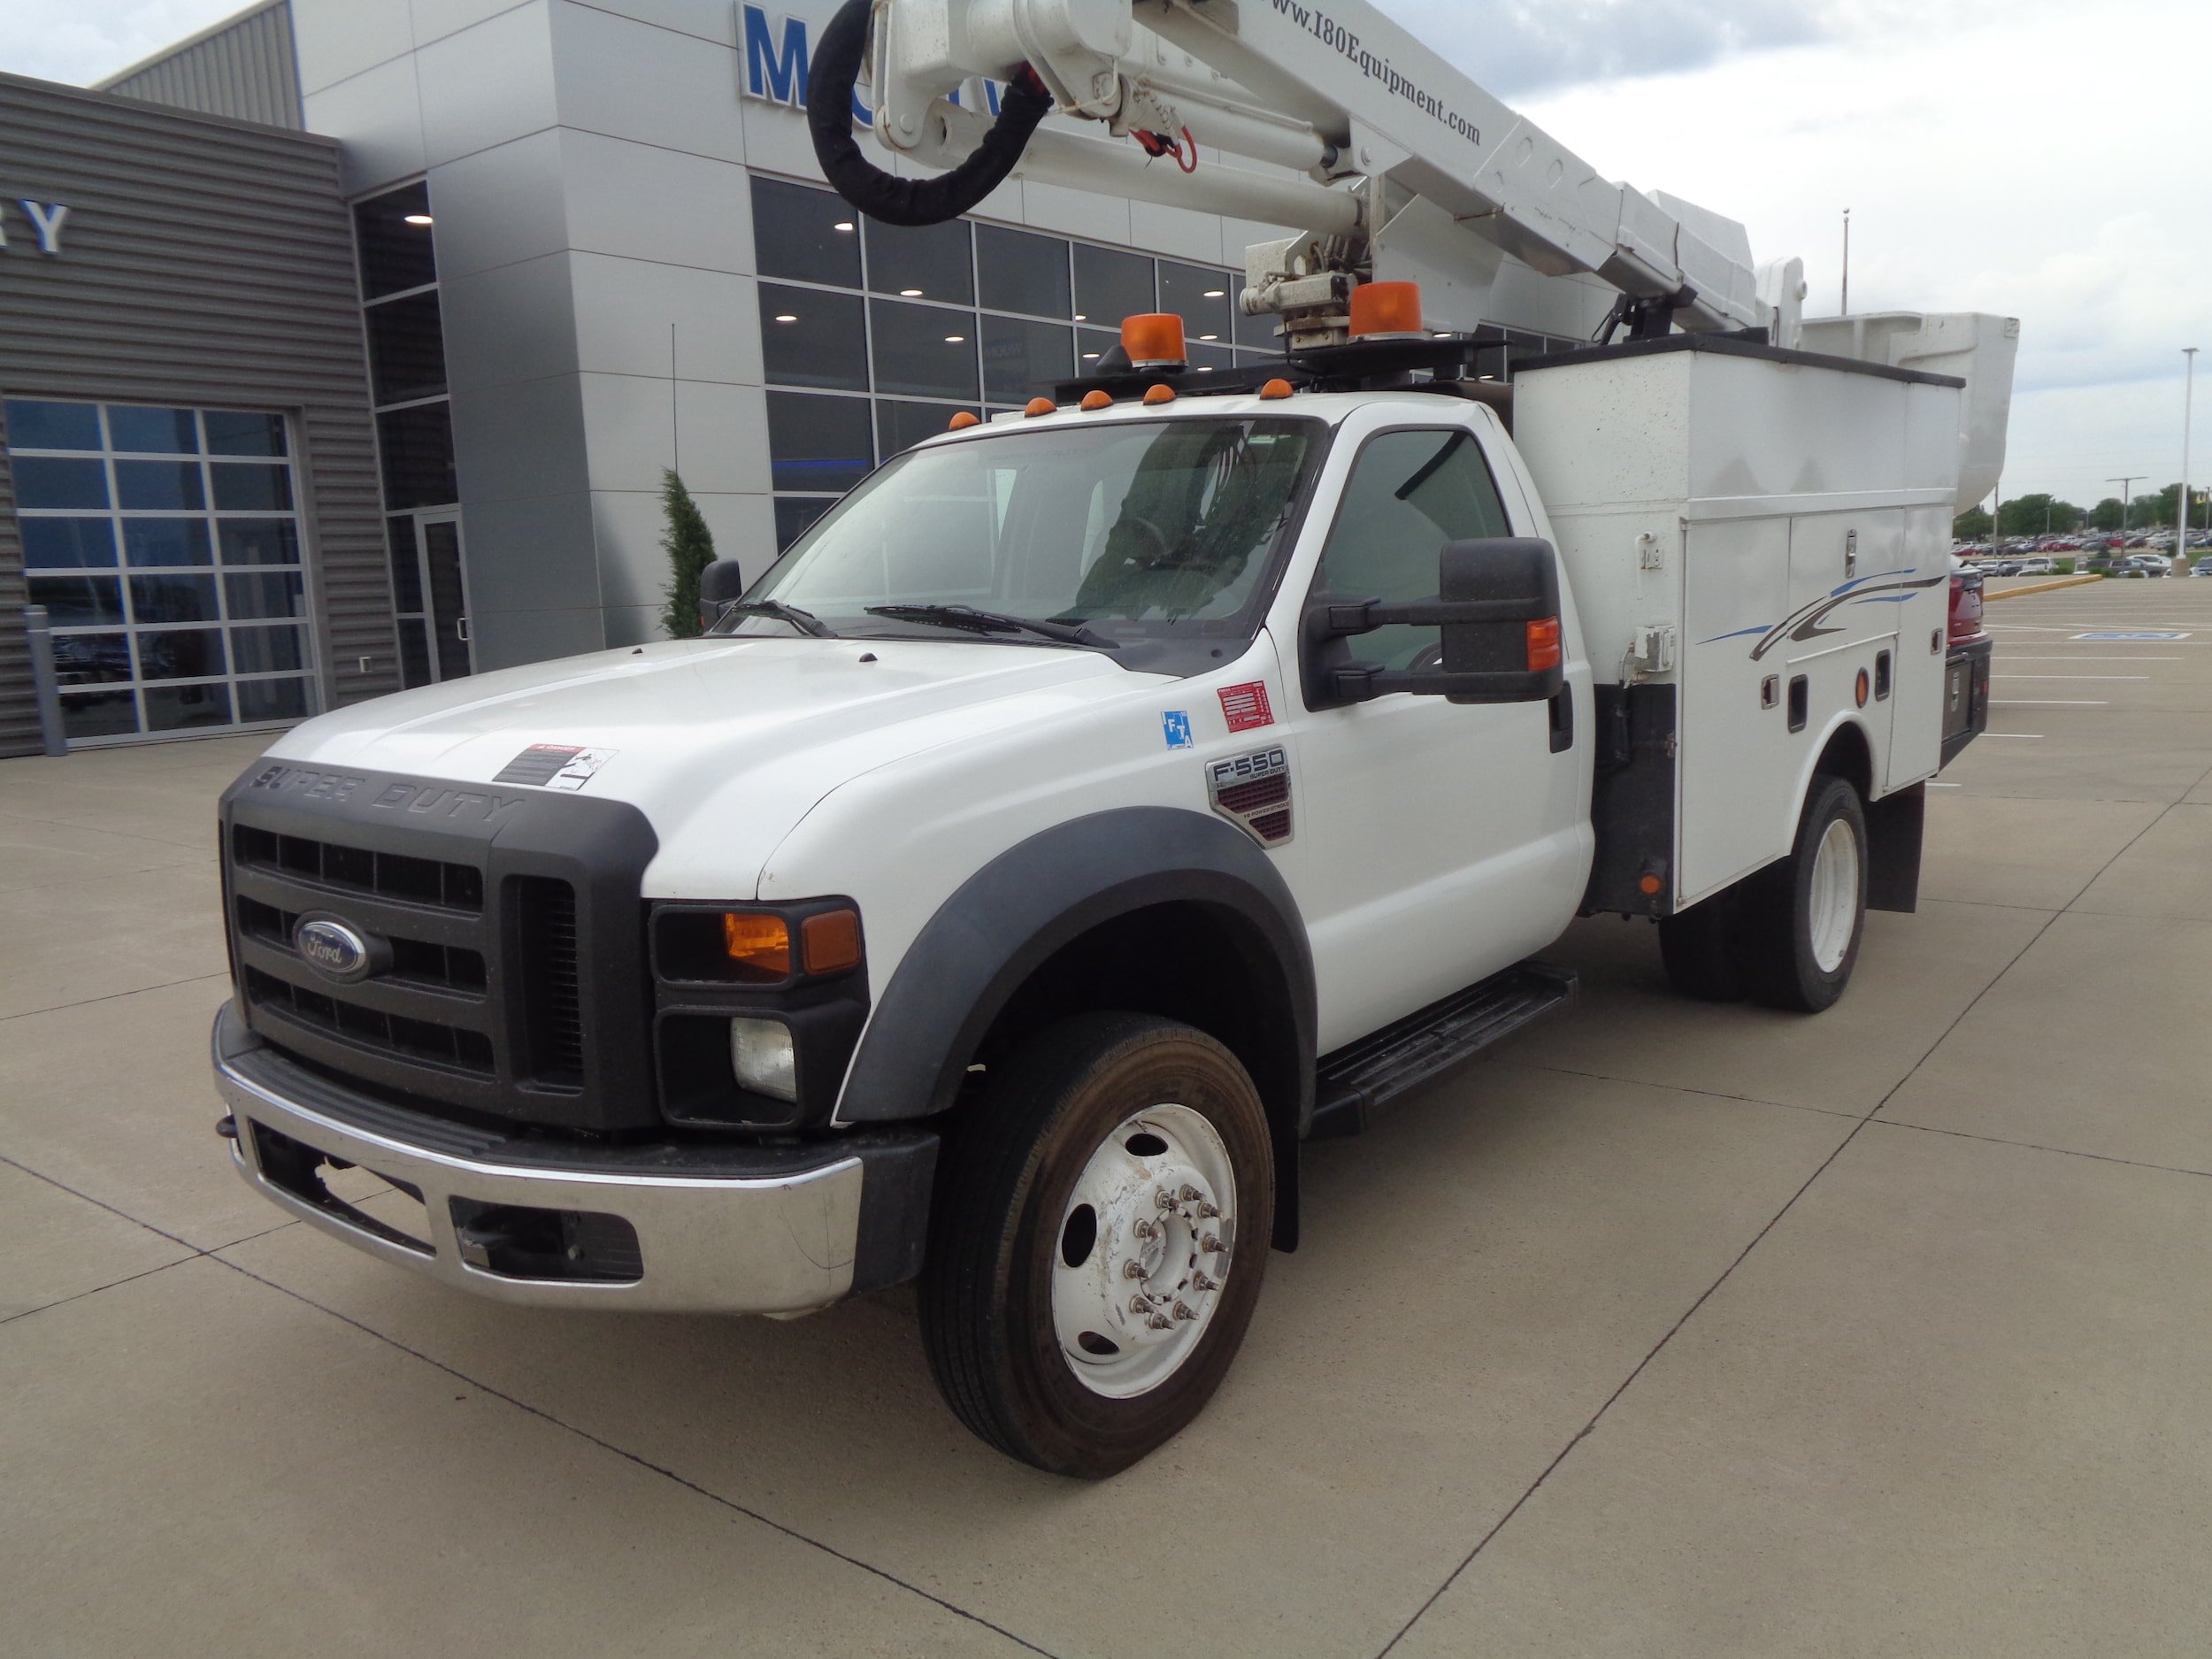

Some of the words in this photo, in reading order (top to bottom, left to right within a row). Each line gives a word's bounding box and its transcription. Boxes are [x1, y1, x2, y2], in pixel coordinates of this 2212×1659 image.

[1213, 749, 1285, 781] F-550
[1249, 770, 1270, 780] SUPER
[1270, 765, 1286, 775] DUTY
[372, 783, 524, 821] DUTY
[307, 933, 343, 964] Ford
